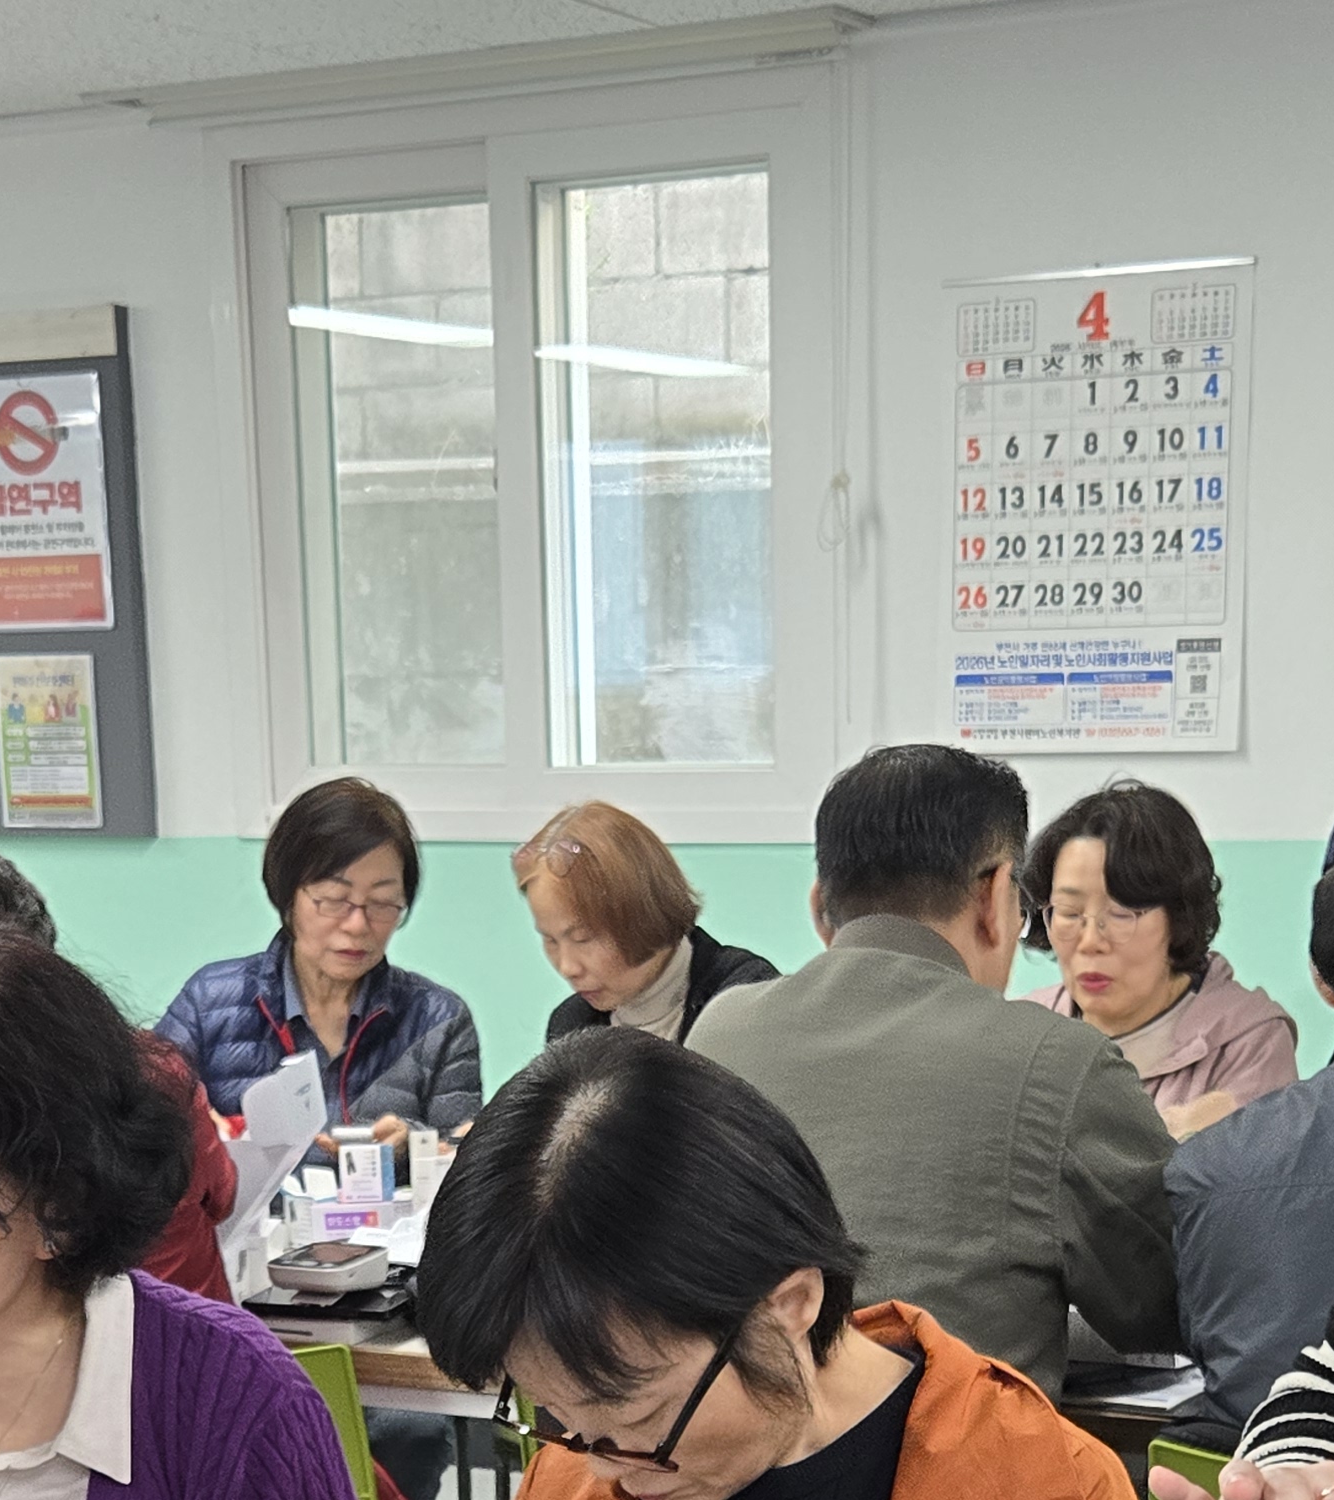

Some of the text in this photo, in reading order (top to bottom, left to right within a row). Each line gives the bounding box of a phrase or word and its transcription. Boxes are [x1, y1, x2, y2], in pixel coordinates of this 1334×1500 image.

[1077, 289, 1110, 341] 4
[966, 346, 1224, 377] 日 月 火 水 木 金 土
[1087, 374, 1219, 406] 1 2 3 4
[966, 425, 1223, 462] 5 6 7 8 9 10 11
[960, 476, 1222, 512] 12 13 14 15 16 17 18
[960, 527, 1223, 561] 19 20 21 22 23 24 25
[957, 580, 1142, 610] 26 27 28 29 30
[955, 653, 996, 671] 2026년
[997, 653, 1051, 669] 노인일자리
